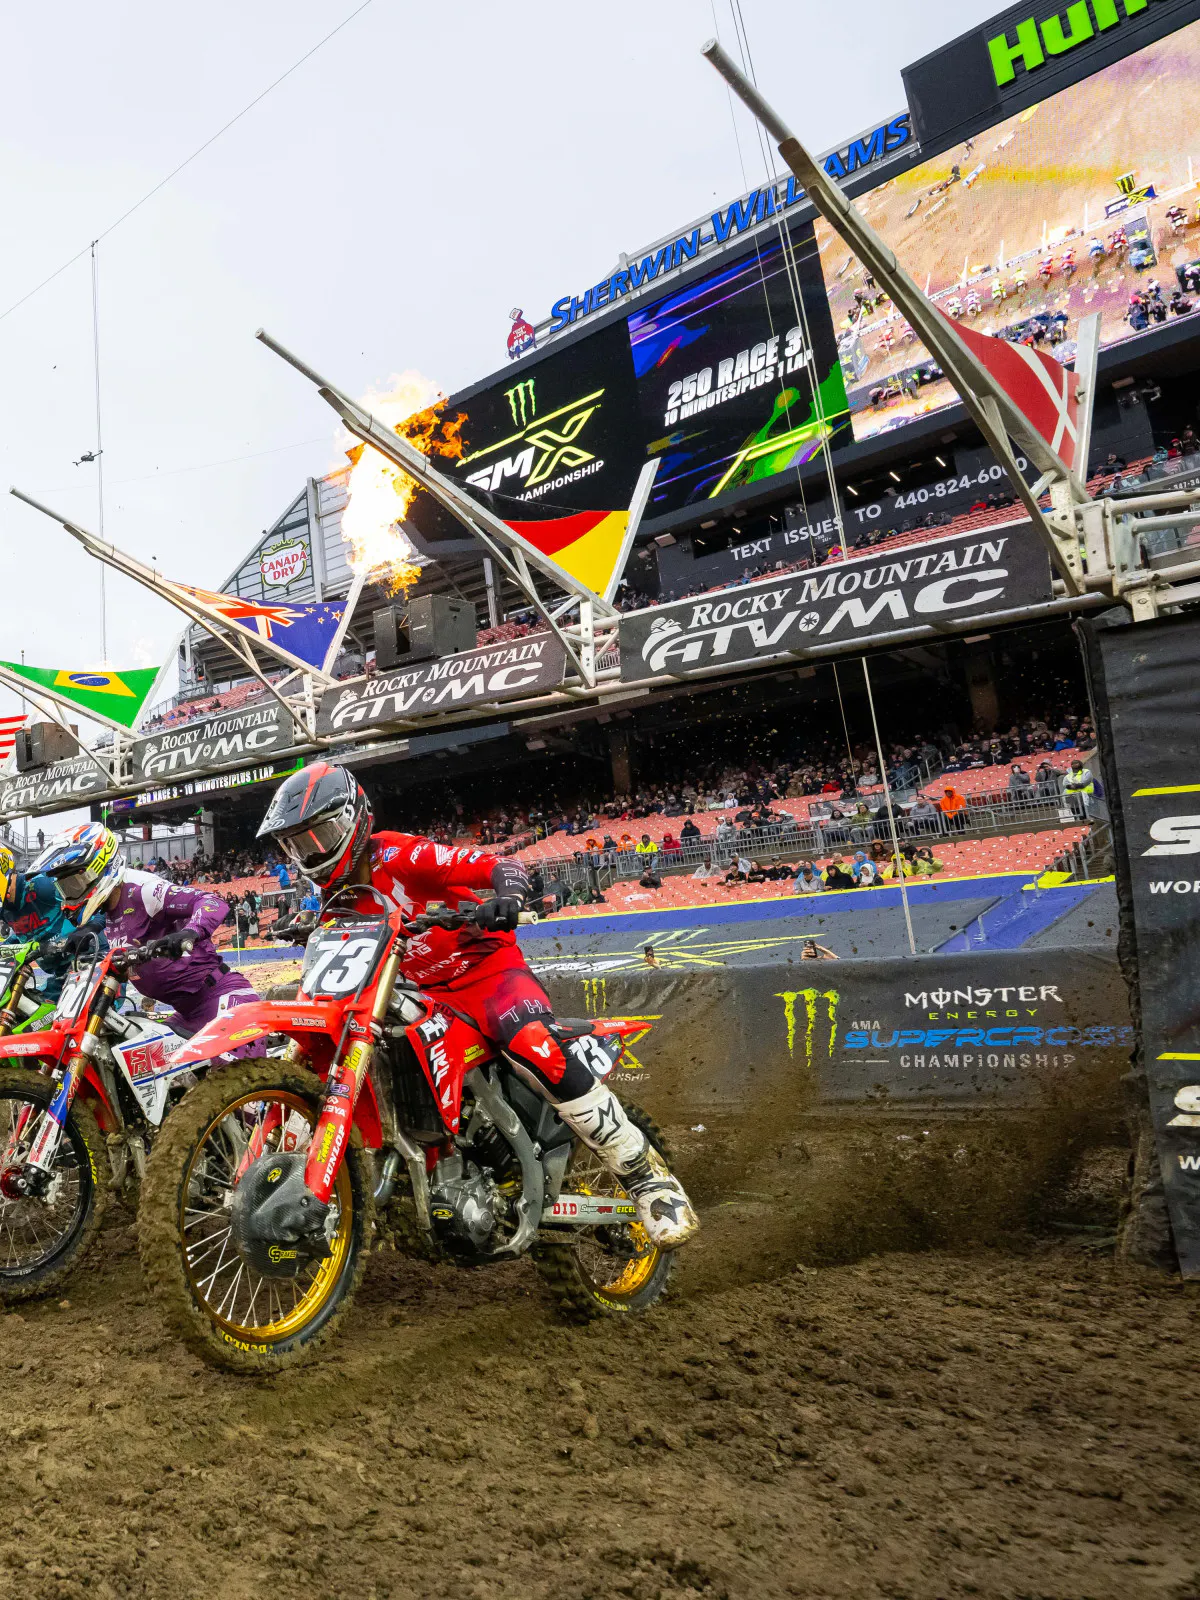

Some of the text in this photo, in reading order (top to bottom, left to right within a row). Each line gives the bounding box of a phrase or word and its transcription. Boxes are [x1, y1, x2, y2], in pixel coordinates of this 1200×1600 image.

[549, 113, 911, 333] SHERWIN-WILLAMS
[667, 326, 803, 410] 250 RACE 3
[664, 350, 814, 427] 10 MINUTES/PLUS 1 LAP
[515, 460, 605, 501] HAMPIONSHIP
[730, 538, 772, 561] TEXT
[784, 518, 844, 545] ISSUES
[854, 505, 882, 523] TO
[261, 551, 307, 573] CANADA
[273, 565, 295, 580] DRY
[687, 538, 1008, 629] ROCKY MOUNTAIN
[363, 641, 547, 698] ROCKY MOUNTAIN
[160, 708, 279, 751] ROCKY MOUNTAIN
[15, 760, 98, 788] ROCKY MOUNTAIN
[259, 766, 274, 779] LAP
[91, 836, 116, 874] EKS
[301, 937, 379, 993] 73
[904, 985, 1064, 1009] MONSTER
[928, 1008, 1038, 1020] ENERGY
[851, 1020, 881, 1031] AMA
[900, 1054, 1076, 1069] CHAMPIONSHIP
[323, 1124, 346, 1188] DUNLOP
[552, 1202, 577, 1215] DID
[616, 1205, 637, 1214] EXCEL
